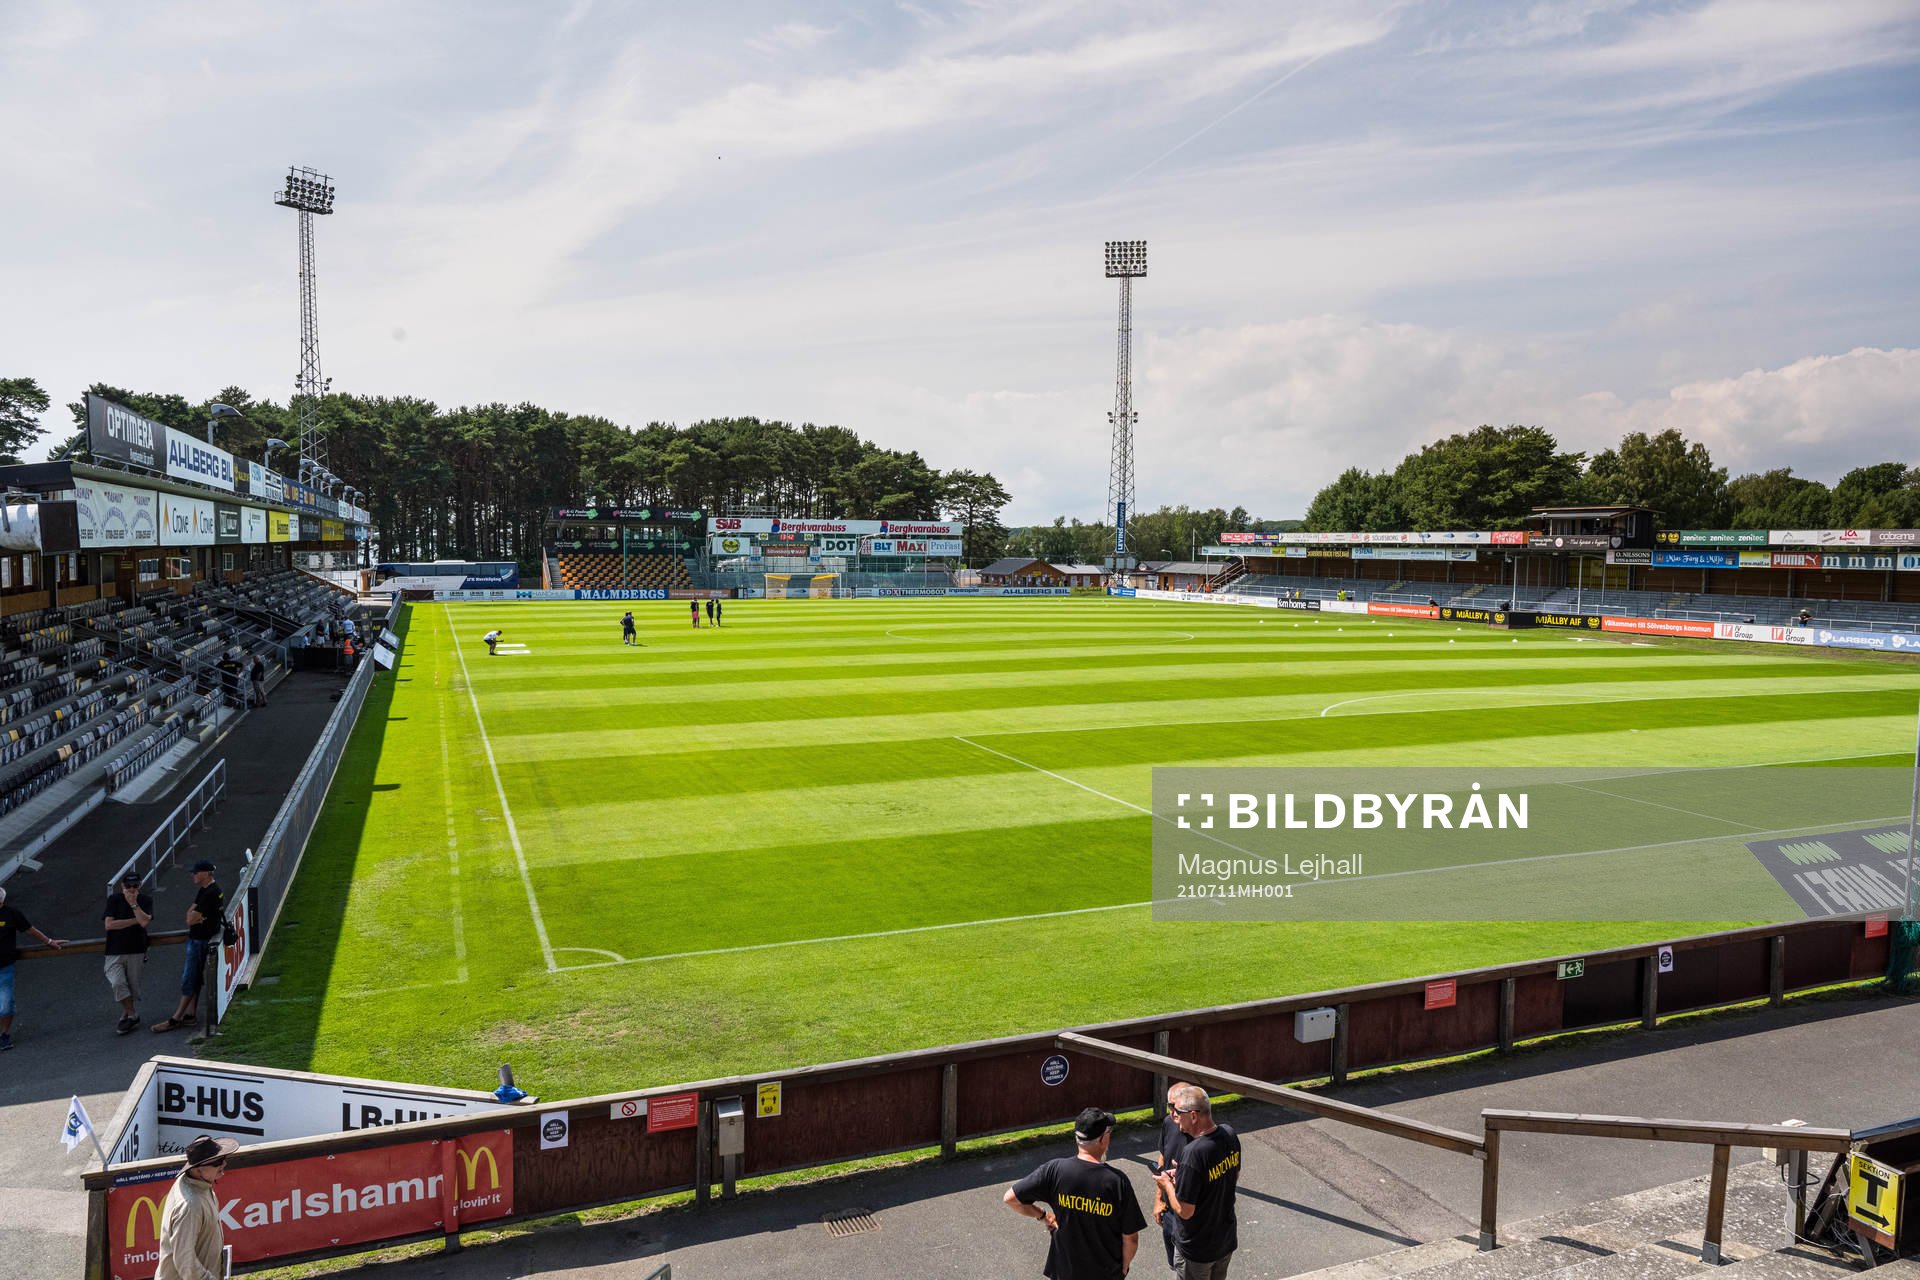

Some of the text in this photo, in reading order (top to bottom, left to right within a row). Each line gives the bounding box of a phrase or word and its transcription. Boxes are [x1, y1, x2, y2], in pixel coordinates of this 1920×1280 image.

[106, 405, 155, 450] OPTIMERA
[169, 439, 219, 478] AHLBERG
[221, 457, 233, 483] BIL
[781, 522, 846, 534] Bergkvarabuss
[889, 523, 950, 535] Bergkvarabuss
[1683, 534, 1706, 542] zenitec
[1710, 534, 1735, 542] zenitec
[1738, 534, 1764, 542] zenitec
[1879, 531, 1915, 540] colorama
[874, 542, 892, 550] BLT
[1773, 554, 1804, 565] PUMA
[581, 589, 665, 600] MALMBERGS
[1456, 609, 1481, 620] MJÄLLBY
[1536, 614, 1582, 626] MJÄLLBY AIF
[1604, 619, 1637, 629] Välkommen
[1647, 622, 1683, 633] Sölvesborgs
[1734, 632, 1753, 640] Group
[1785, 634, 1805, 643] Group
[1832, 636, 1885, 646] LARSSON
[158, 1082, 265, 1122] B-HUS
[1858, 1160, 1891, 1180] SEKTION
[1858, 1169, 1889, 1207] T
[492, 1193, 501, 1205] it
[1058, 1194, 1113, 1217] MATCHVÄRD
